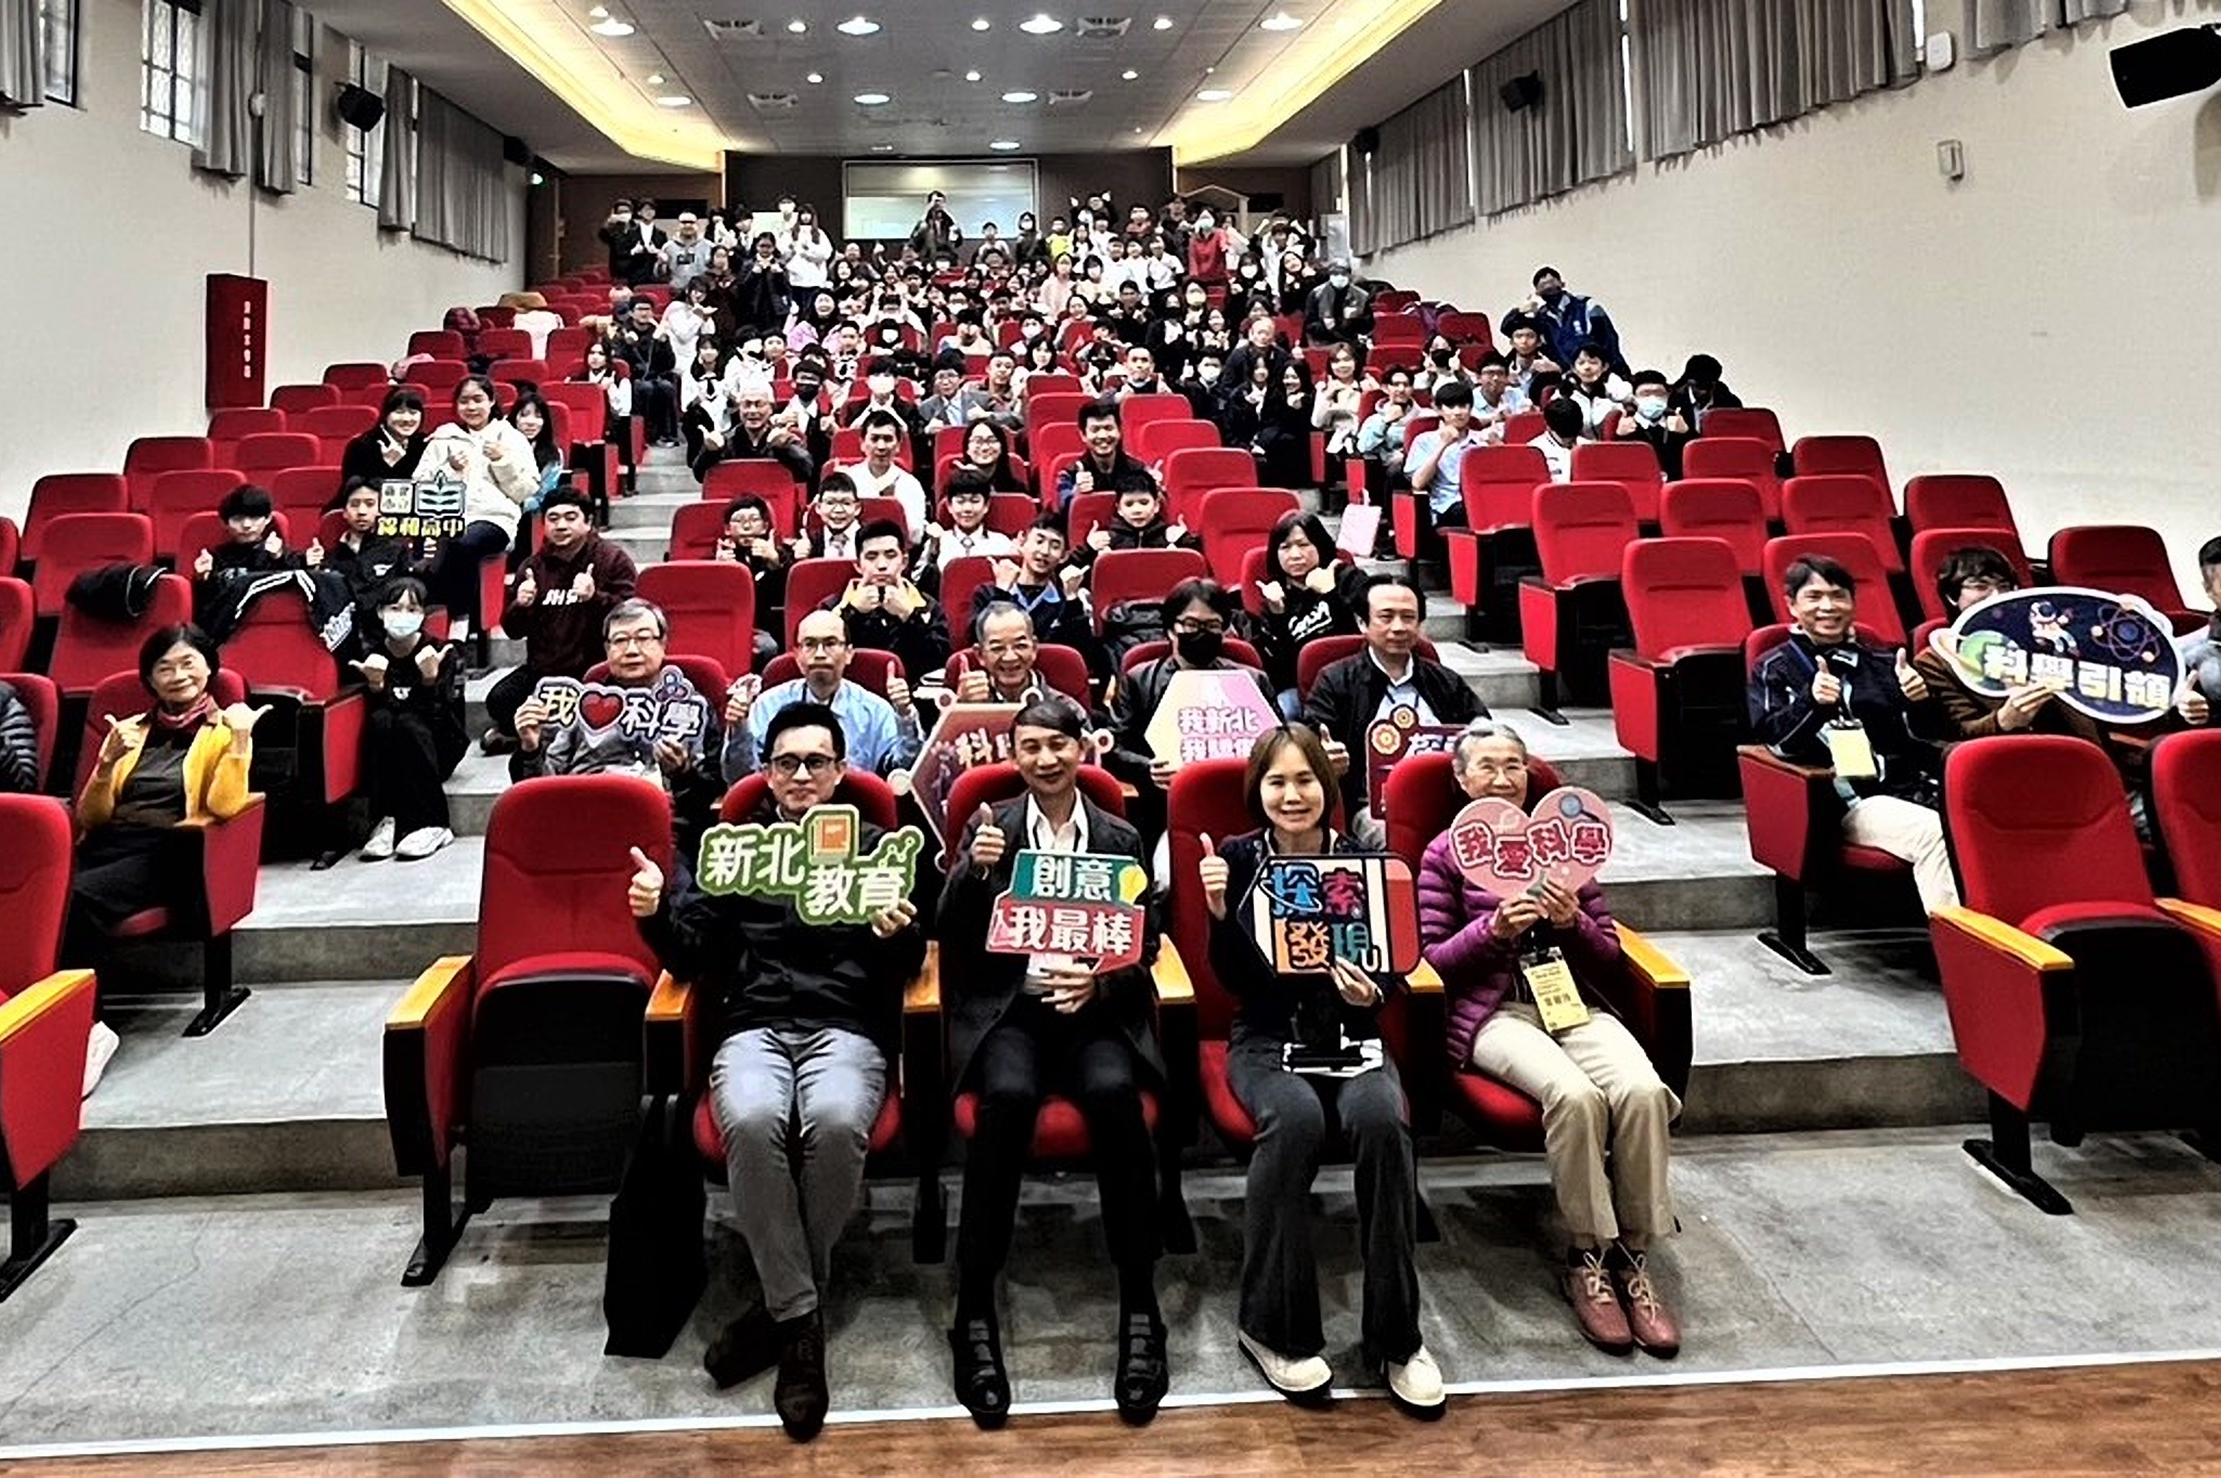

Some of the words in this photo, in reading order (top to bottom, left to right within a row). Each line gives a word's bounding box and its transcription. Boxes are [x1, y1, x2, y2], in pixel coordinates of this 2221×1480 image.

[1983, 645, 2171, 710] 科學引領
[539, 686, 580, 726] 我
[620, 697, 700, 737] 科學
[704, 834, 806, 887] 新北
[1453, 818, 1610, 877] 我愛科學
[804, 864, 907, 916] 教育
[1031, 855, 1114, 901] 創意
[1270, 866, 1365, 918] 探索
[1009, 906, 1132, 956] 我最棒
[1287, 920, 1380, 972] 發現
